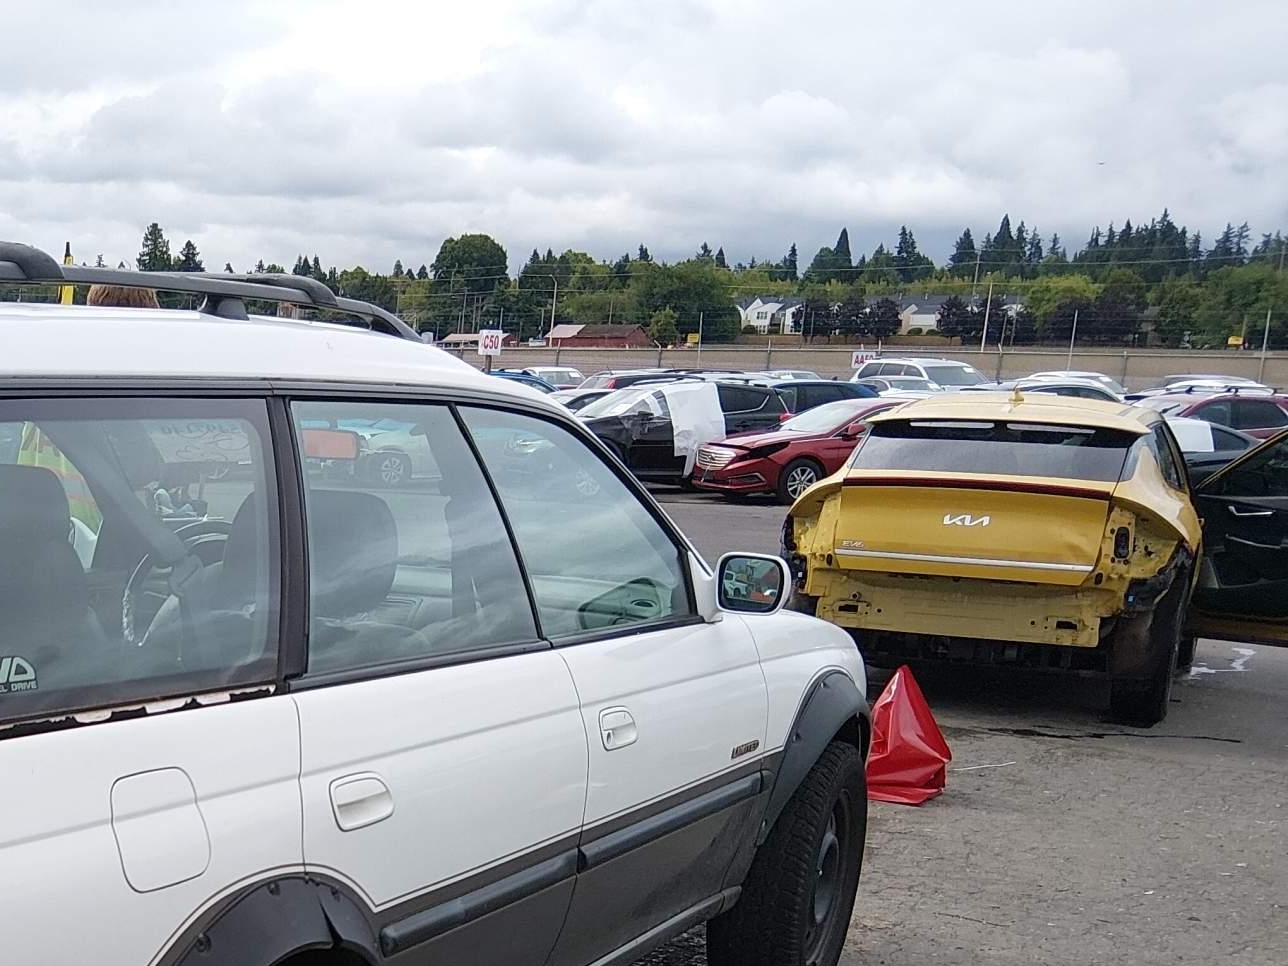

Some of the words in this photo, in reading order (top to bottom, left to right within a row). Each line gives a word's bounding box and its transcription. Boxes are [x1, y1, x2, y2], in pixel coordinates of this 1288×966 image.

[484, 335, 500, 349] C50
[942, 514, 991, 527] KIA
[10, 680, 37, 691] DRIVE
